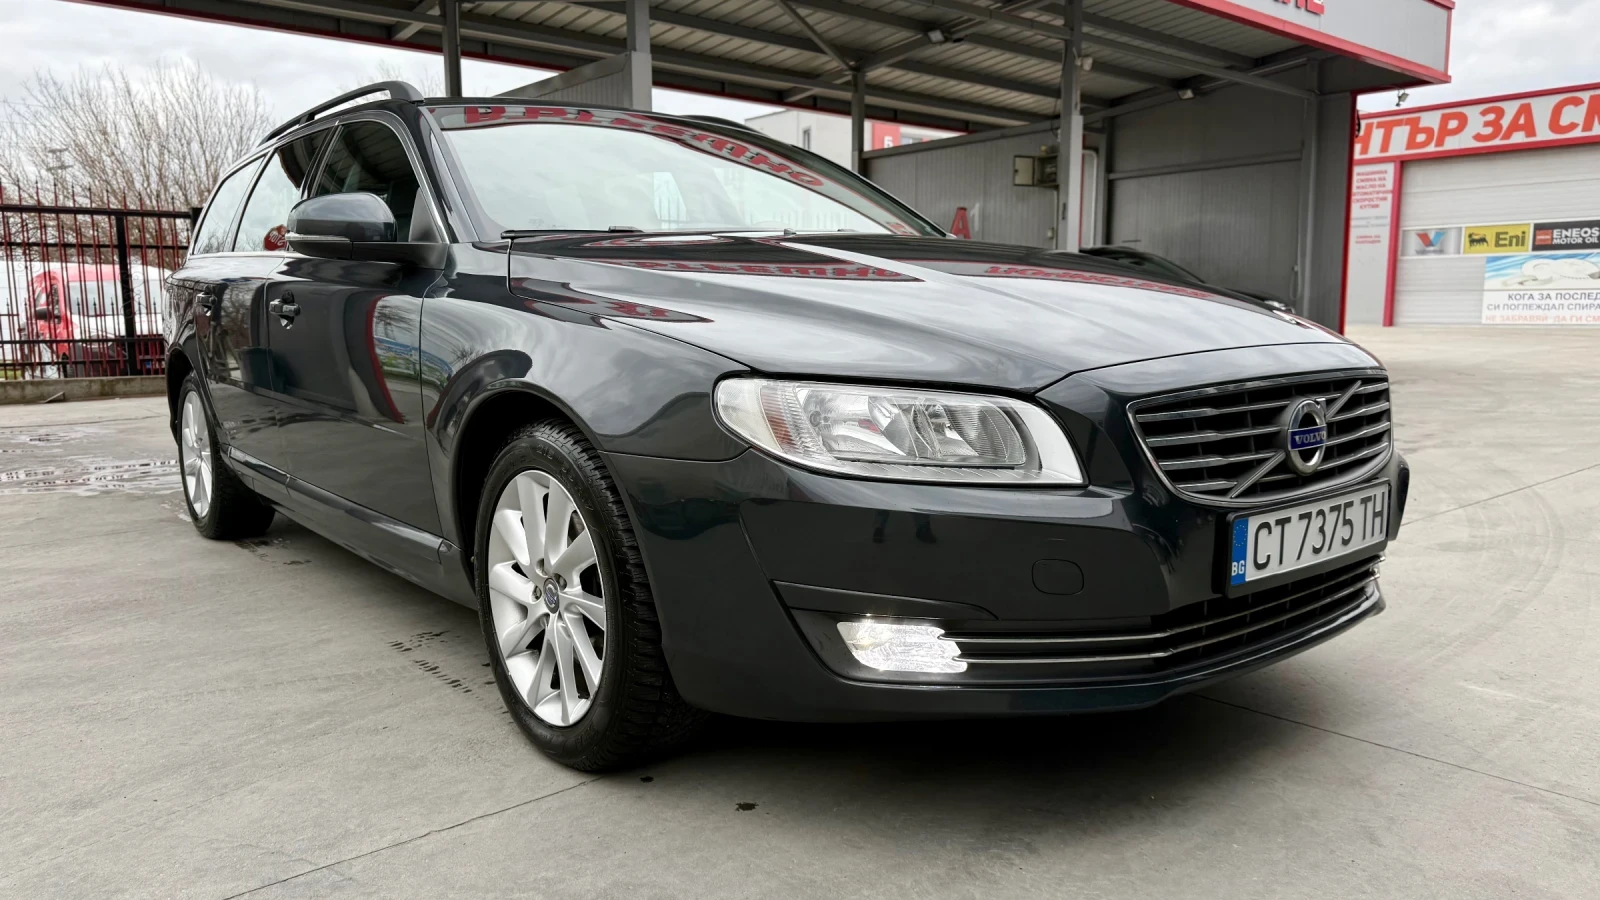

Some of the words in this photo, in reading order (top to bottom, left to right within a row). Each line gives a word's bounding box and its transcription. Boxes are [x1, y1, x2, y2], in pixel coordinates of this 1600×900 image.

[1472, 102, 1537, 143] ЗА
[1494, 231, 1526, 248] Eni
[1552, 227, 1600, 238] ENEOS
[1552, 237, 1583, 245] MOTOR
[1585, 236, 1599, 244] OIL
[1508, 293, 1535, 301] КОГА
[1537, 292, 1552, 301] ЗА
[1487, 303, 1501, 311] СИ
[1502, 303, 1565, 312] ПОГЛЕЖДАЛ
[1293, 431, 1326, 445] VOLVO
[1253, 516, 1292, 570] CT
[1296, 500, 1354, 561] 7375
[1360, 491, 1385, 541] TH
[1231, 560, 1245, 576] BG
